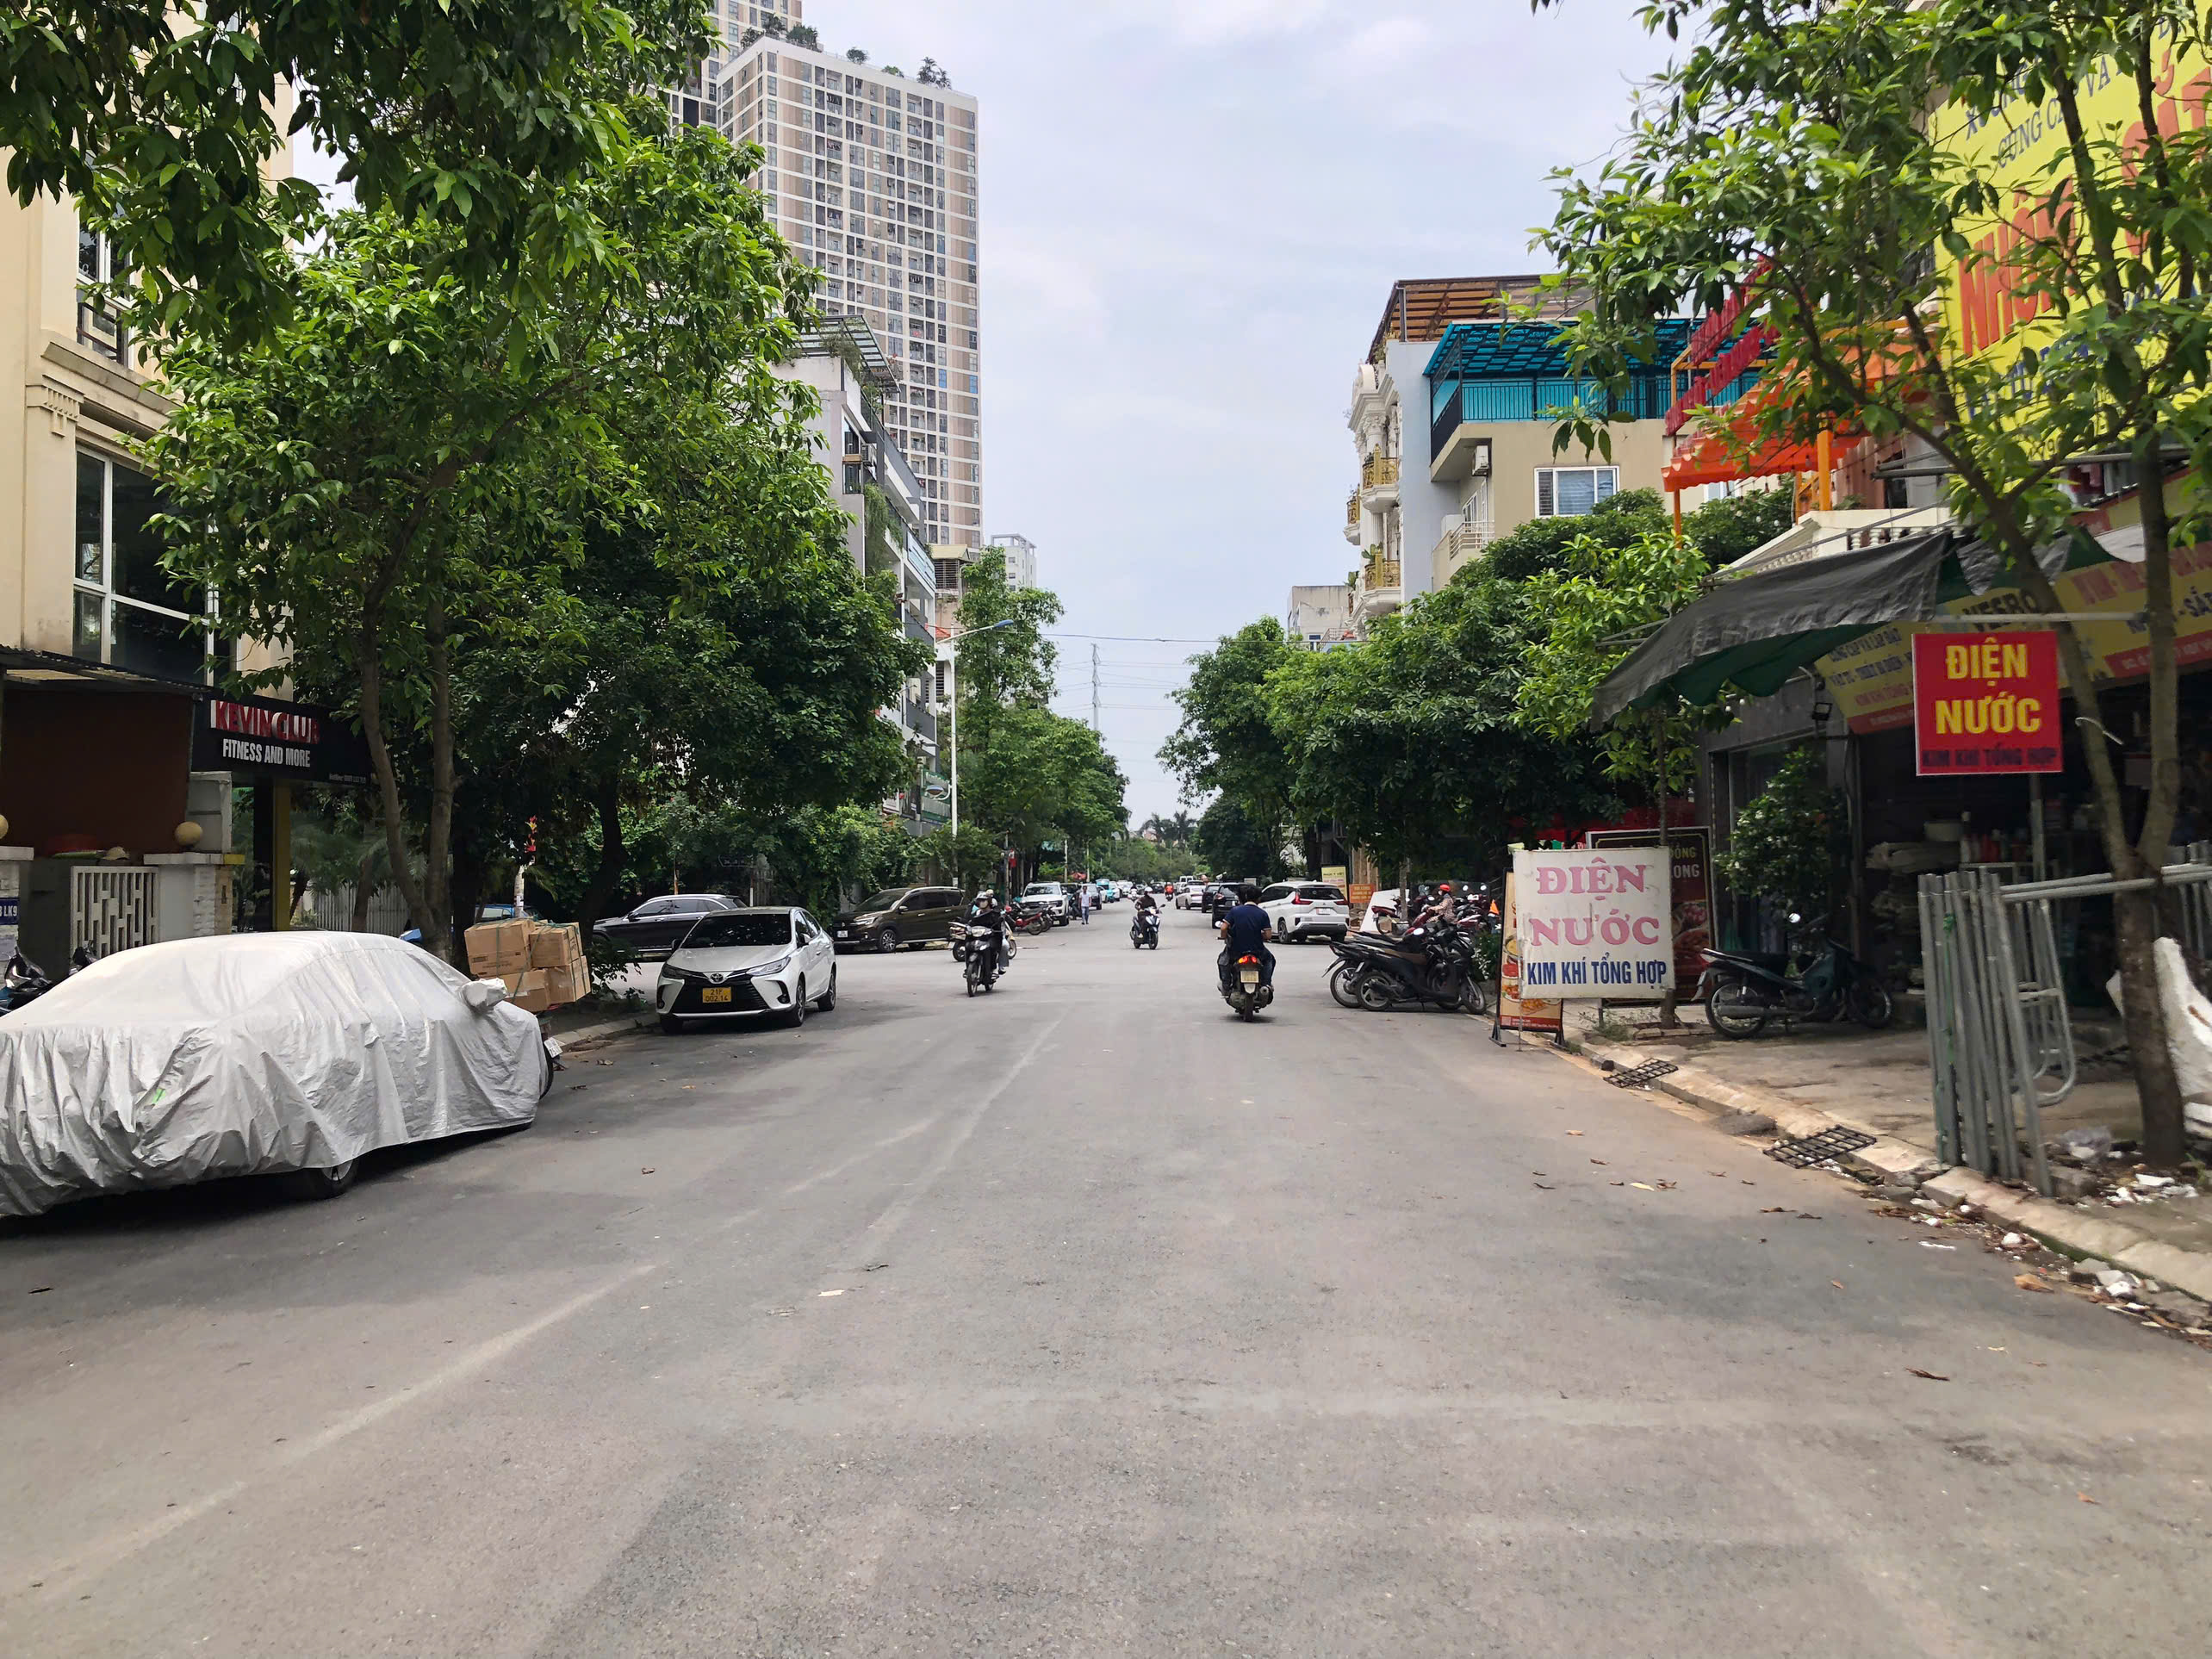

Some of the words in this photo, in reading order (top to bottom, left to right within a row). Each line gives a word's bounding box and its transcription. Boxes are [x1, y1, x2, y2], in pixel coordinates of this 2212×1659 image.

[1998, 109, 2042, 168] CUNG
[1945, 637, 2027, 687] ĐIỆN
[210, 699, 271, 738] KEVIN
[271, 711, 320, 744] CLUB
[1935, 691, 2041, 734] NƯỚC
[222, 738, 263, 762] FITNESS
[264, 744, 283, 764] AND
[285, 748, 311, 767] MORE
[1536, 856, 1647, 901] ĐIỆN
[1671, 863, 1700, 879] ONG
[1528, 908, 1660, 946] NƯỚC
[1527, 962, 1556, 985] KIM
[1561, 956, 1587, 984] KHÍ
[1591, 952, 1632, 984] TỔNG
[1637, 959, 1667, 990] HỢP
